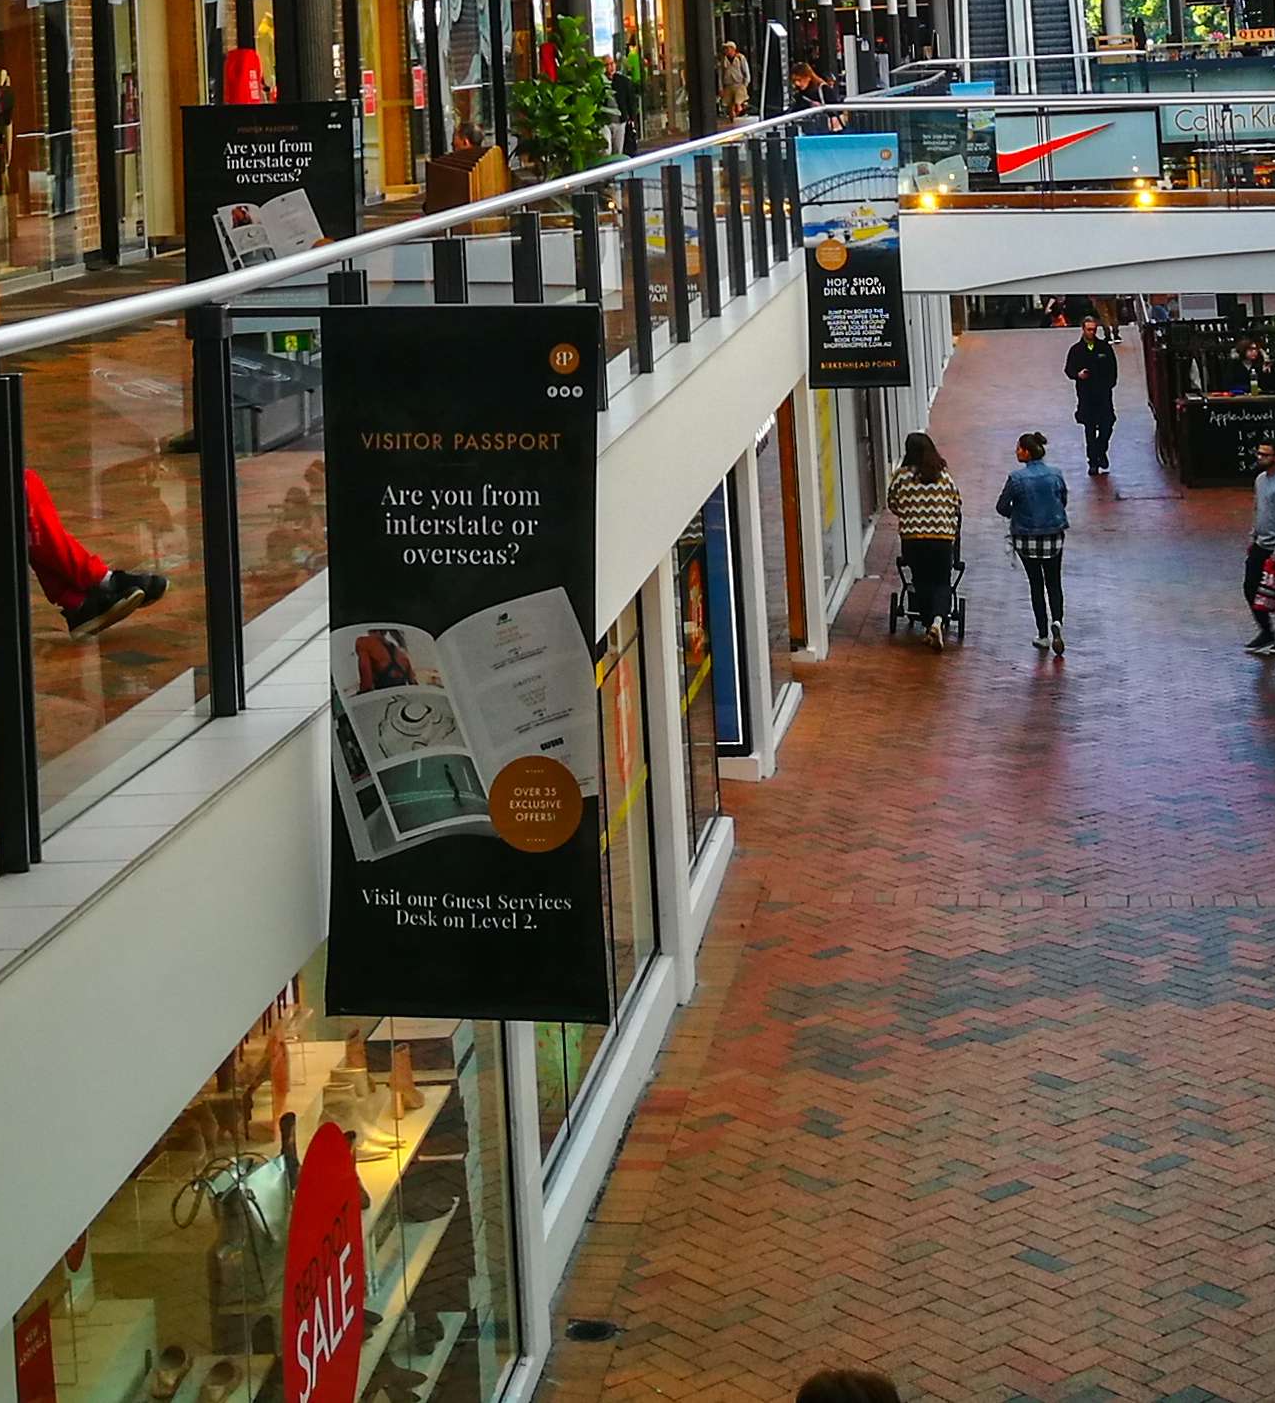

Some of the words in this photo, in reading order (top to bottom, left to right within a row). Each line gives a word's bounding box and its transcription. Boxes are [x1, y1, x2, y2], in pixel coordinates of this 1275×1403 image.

[1175, 108, 1246, 132] Calvin
[223, 142, 247, 155] Are
[251, 142, 276, 156] you
[280, 139, 313, 153] from
[226, 155, 293, 170] interstate
[296, 156, 312, 167] or
[236, 168, 302, 184] overseas?
[826, 278, 850, 288] HOP,
[853, 277, 881, 287] SHOP,
[824, 287, 846, 296] DINE
[850, 287, 857, 295] &
[860, 286, 885, 295] PLAY!
[821, 361, 870, 369] BIRKENHEAD
[361, 433, 442, 449] VISITOR
[454, 433, 561, 450] PASSPORT
[1238, 430, 1243, 440] 1
[1238, 446, 1245, 456] 2
[381, 485, 423, 506] Are
[430, 488, 473, 510] you
[481, 484, 540, 506] from
[386, 512, 503, 535] interstate
[512, 518, 538, 535] or
[403, 542, 520, 565] overseas?
[514, 787, 541, 798] OVER
[544, 786, 557, 797] 35
[509, 799, 562, 810] EXCLUSIVE
[515, 812, 556, 822] OFFERS!
[362, 889, 402, 906] Visit
[407, 893, 437, 908] our
[442, 893, 491, 910] Guest
[498, 894, 572, 910] Services
[396, 910, 437, 927] Desk
[443, 915, 464, 928] on
[471, 913, 516, 929] Level
[523, 914, 538, 929] 2.
[296, 1241, 356, 1403] SALE
